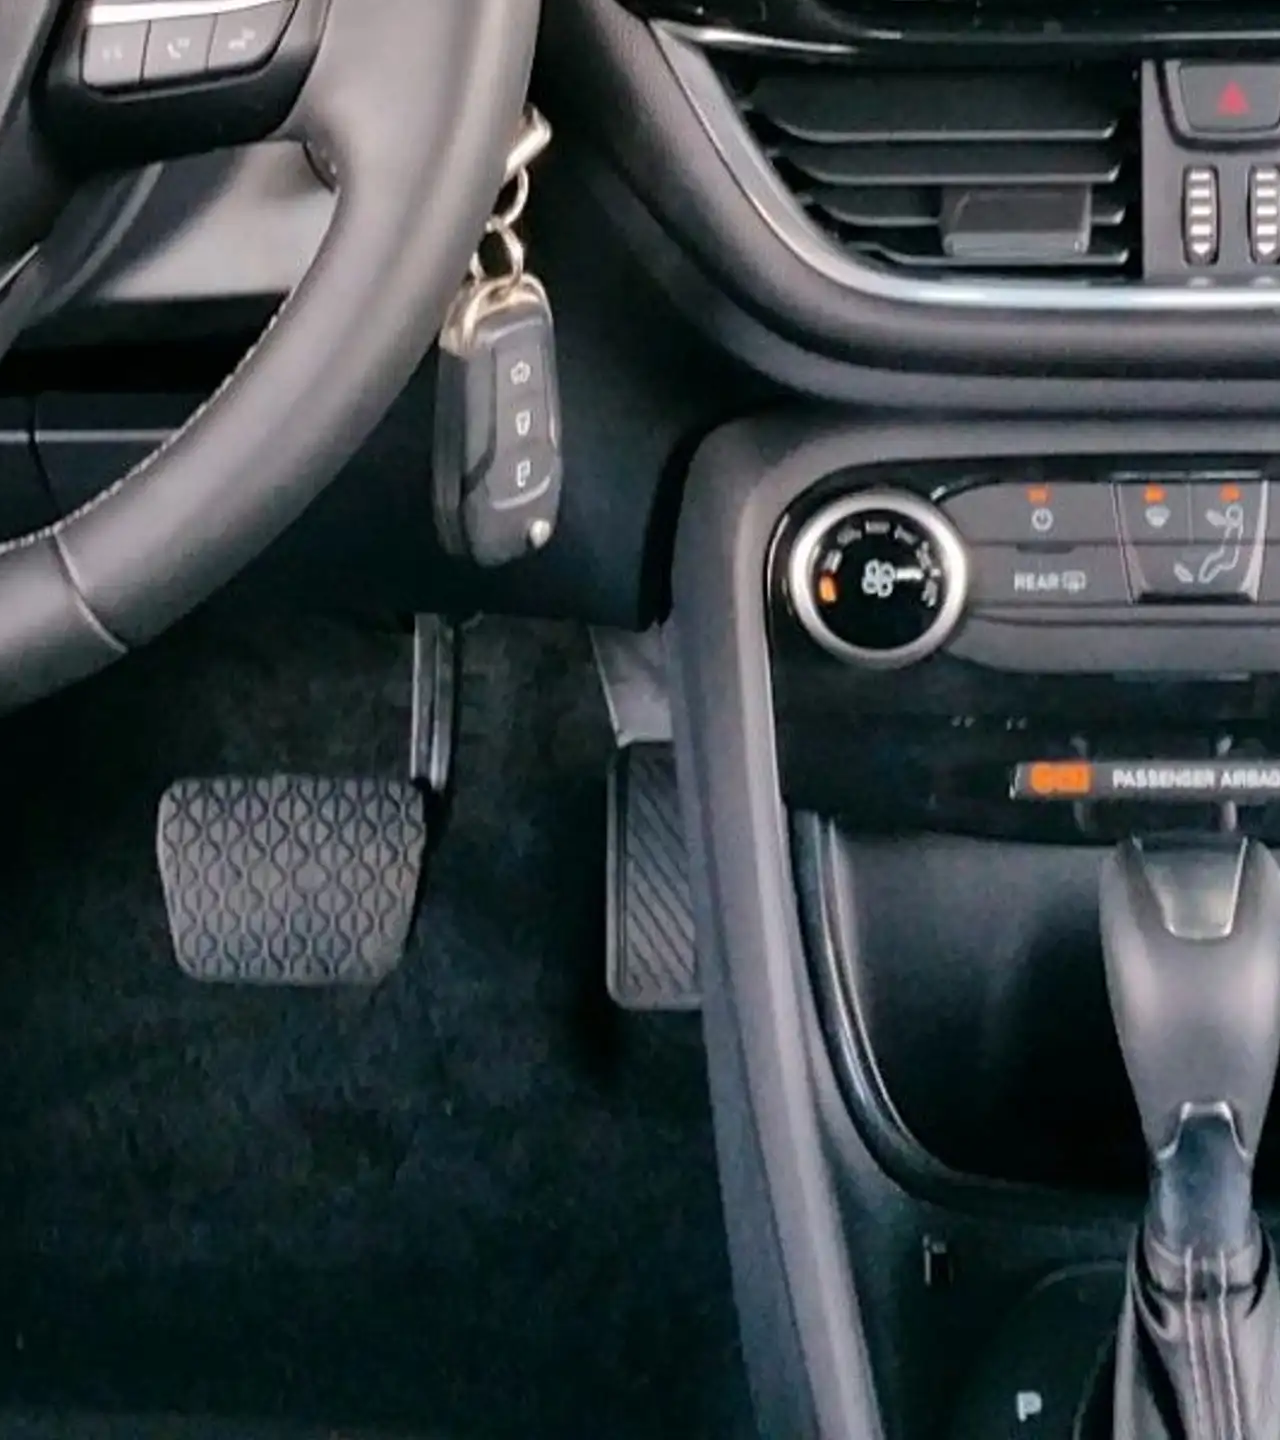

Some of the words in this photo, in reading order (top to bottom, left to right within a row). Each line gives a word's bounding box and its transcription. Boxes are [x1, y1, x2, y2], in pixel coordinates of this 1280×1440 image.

[1014, 572, 1060, 591] REAR
[1112, 767, 1215, 789] PASSENGER
[1016, 1390, 1043, 1422] P
